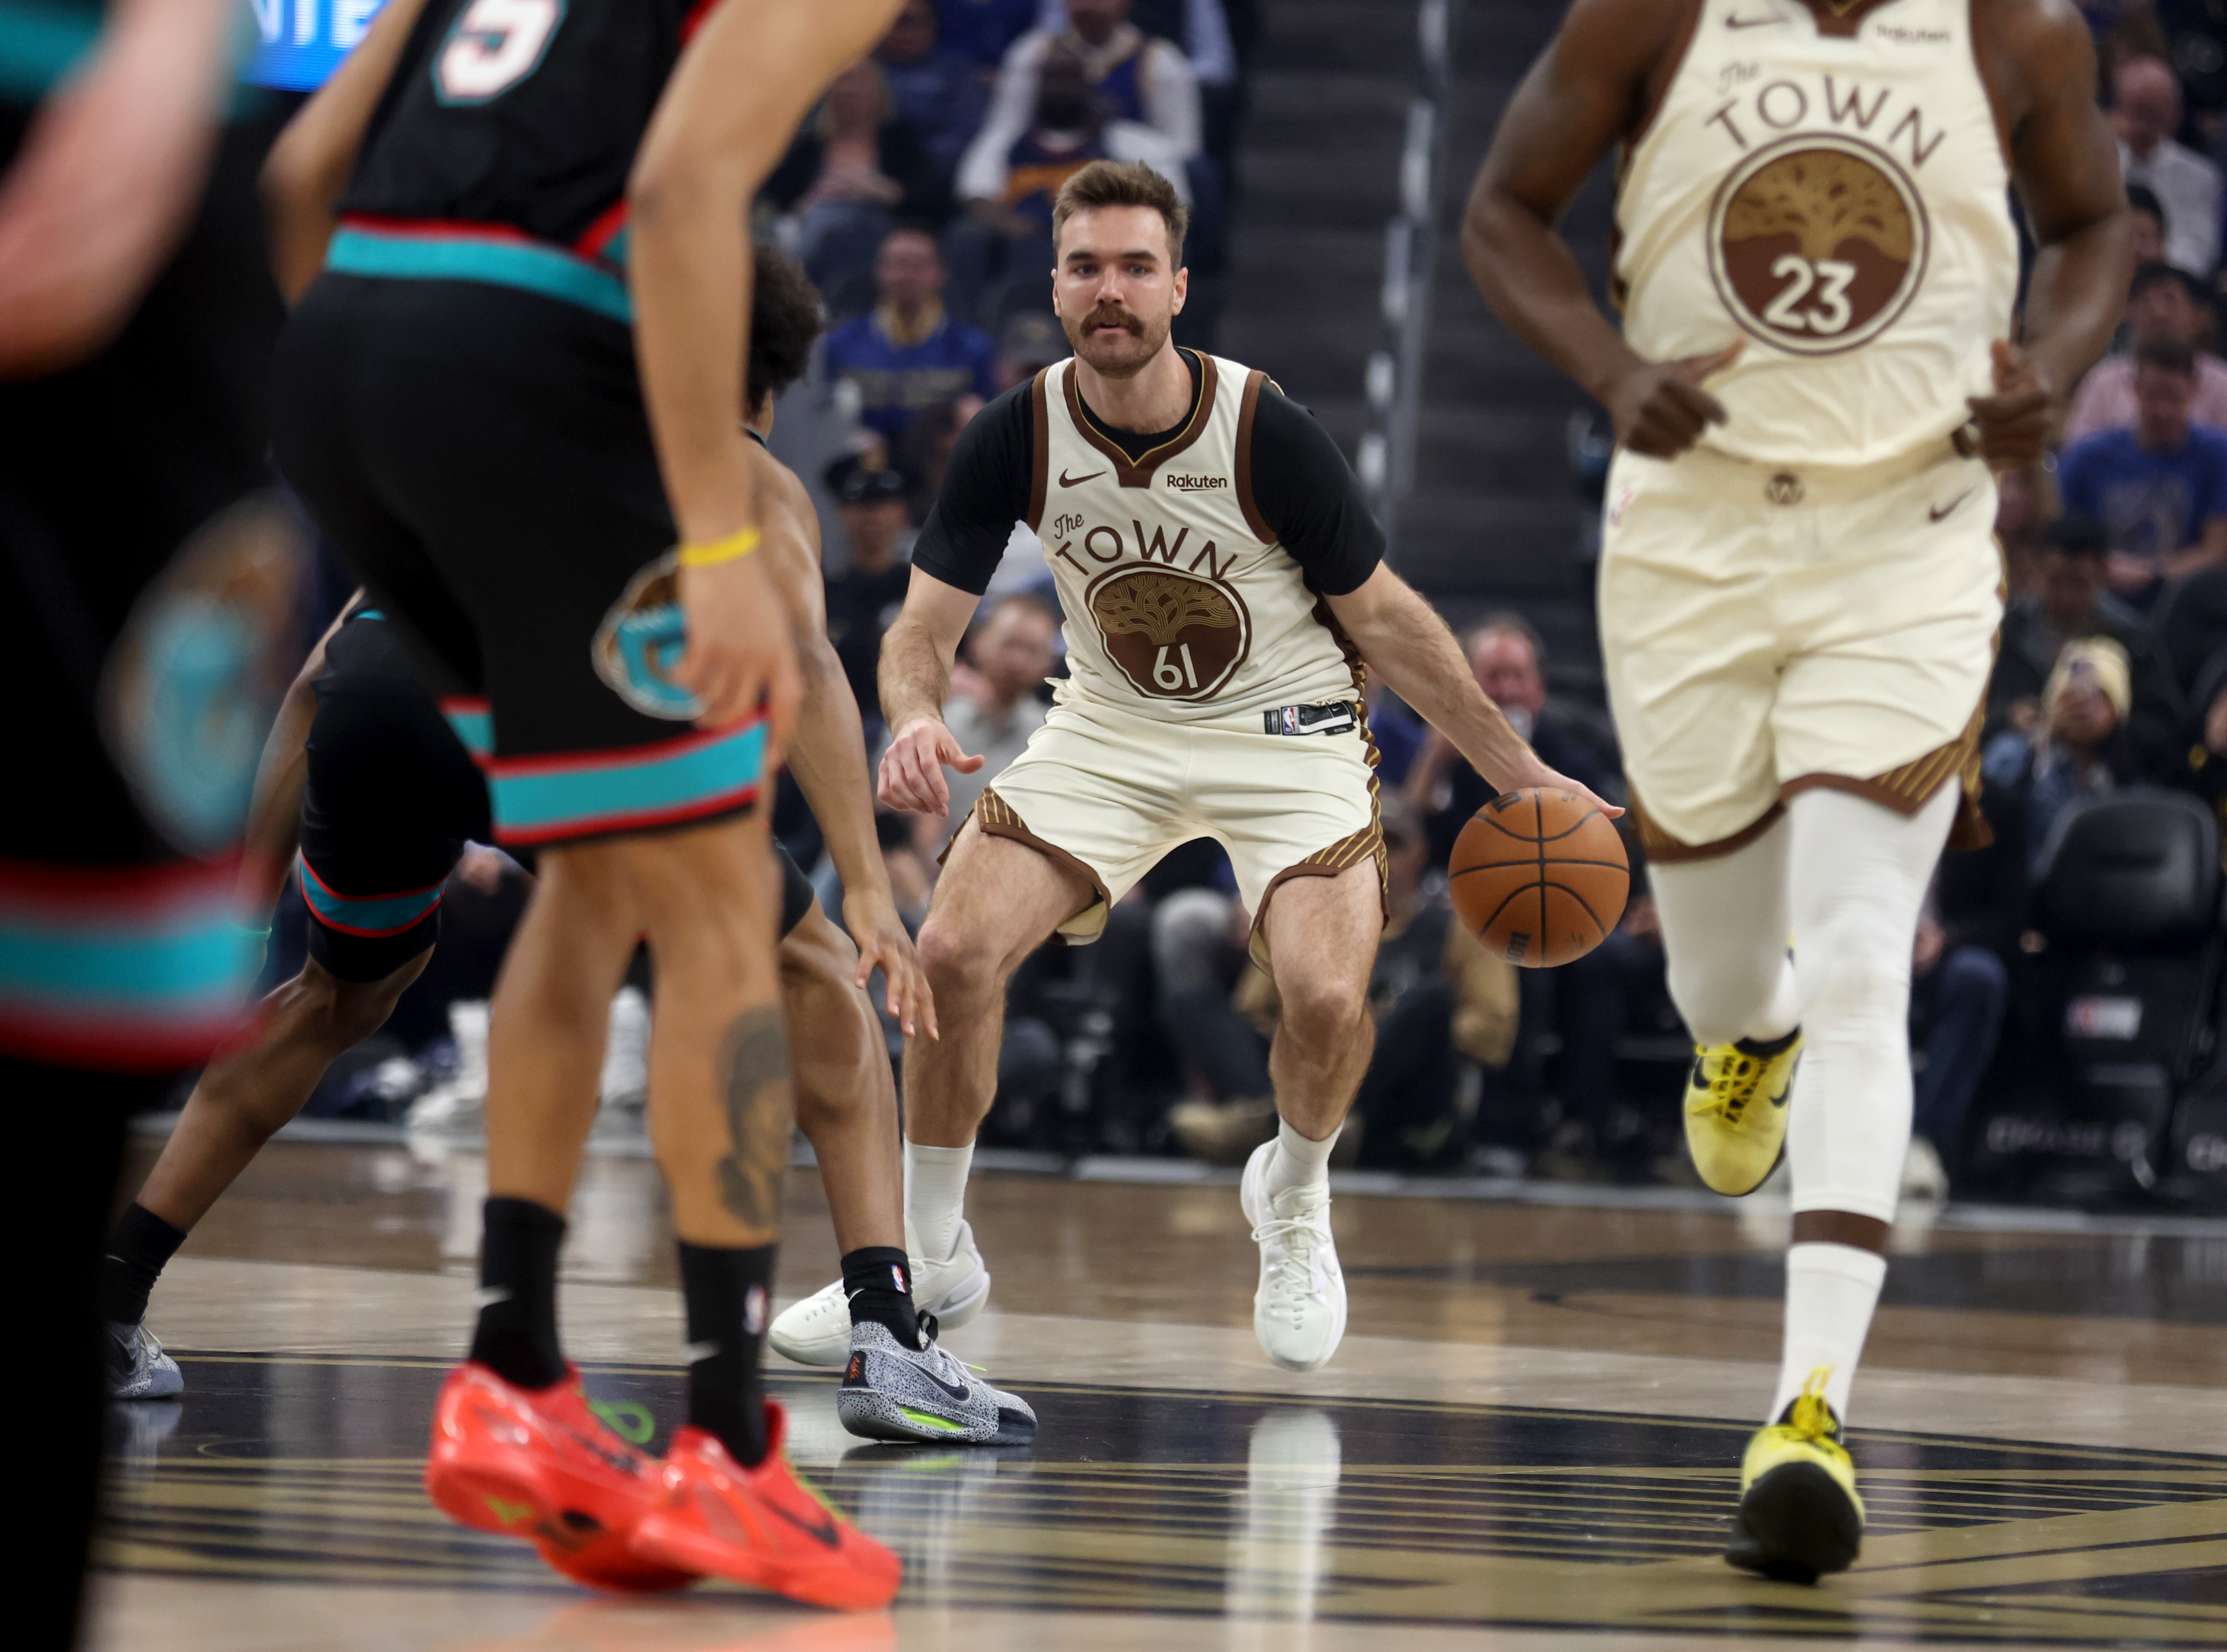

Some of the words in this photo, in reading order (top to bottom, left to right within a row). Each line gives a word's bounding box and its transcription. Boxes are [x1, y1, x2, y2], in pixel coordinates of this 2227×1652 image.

[1705, 74, 1946, 169] TOWN
[1765, 254, 1857, 334] 23
[1166, 474, 1227, 489] Rakuten
[1054, 514, 1084, 539] The
[1055, 519, 1238, 580] TOWN
[1153, 643, 1198, 690] 61
